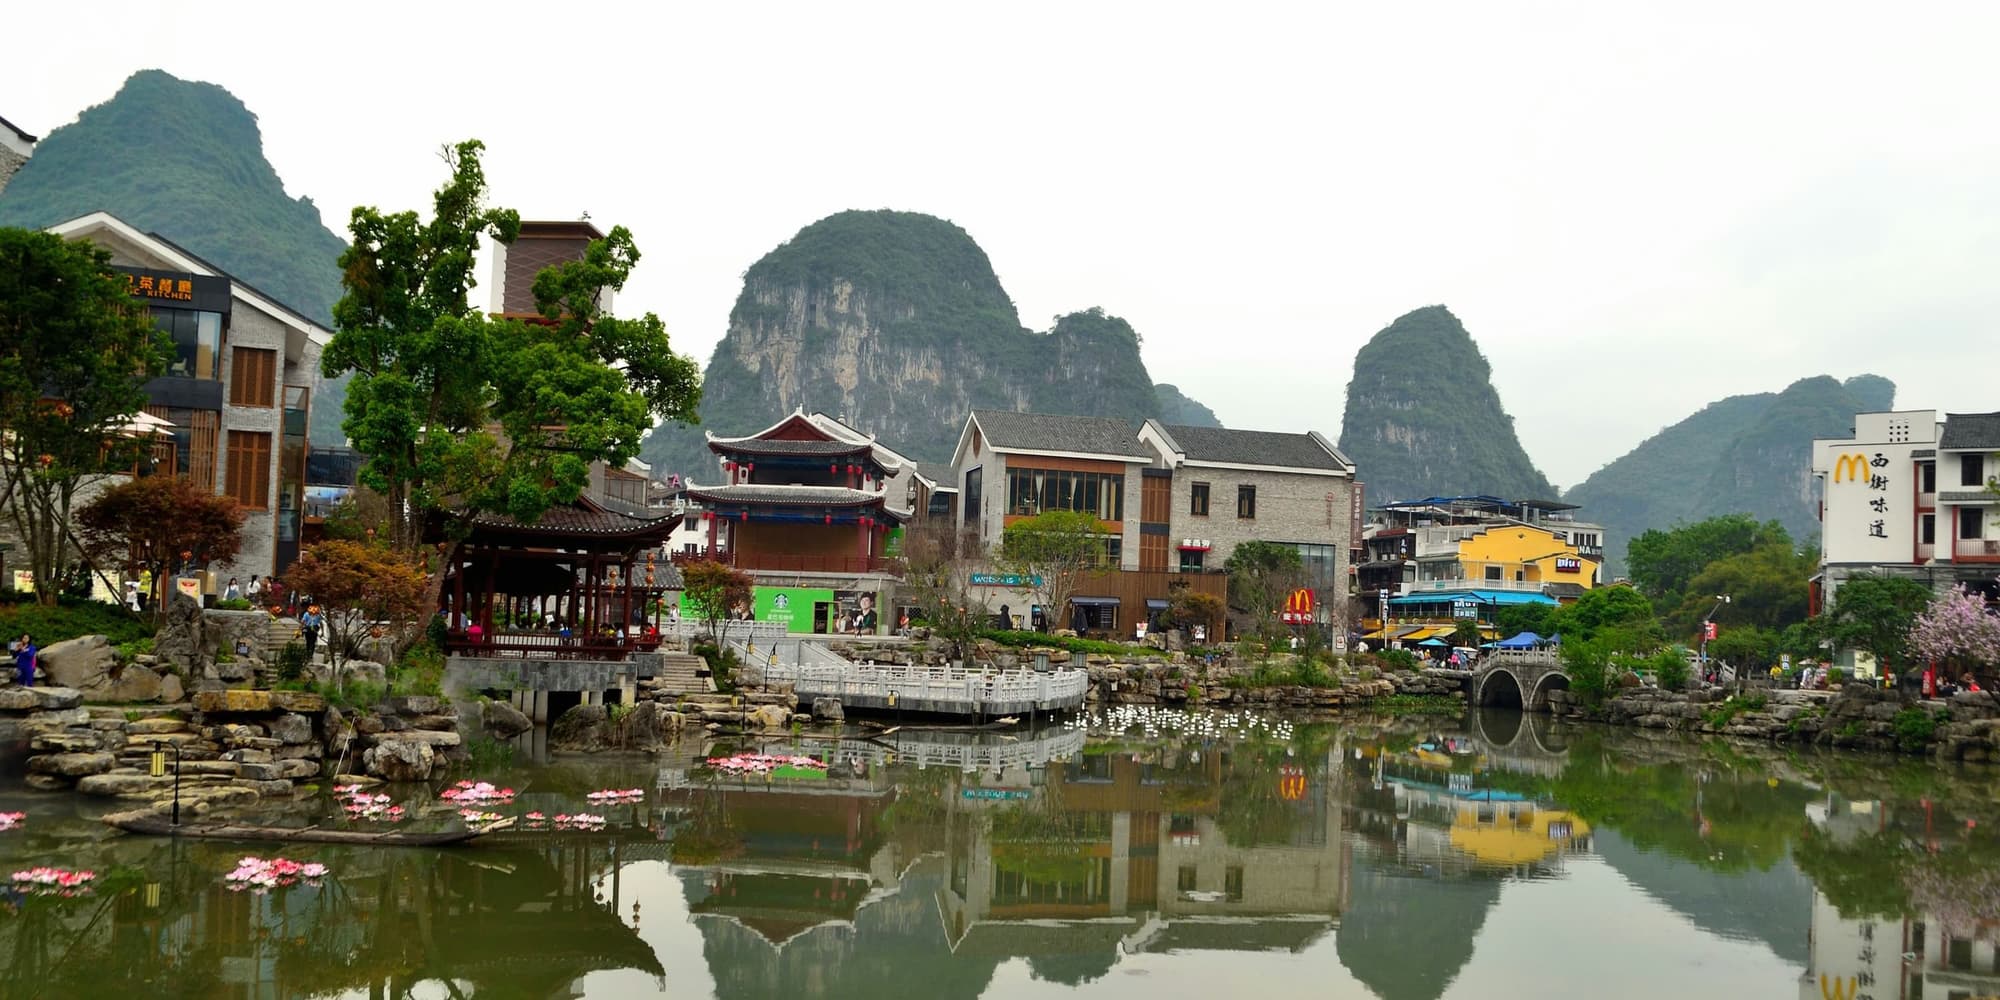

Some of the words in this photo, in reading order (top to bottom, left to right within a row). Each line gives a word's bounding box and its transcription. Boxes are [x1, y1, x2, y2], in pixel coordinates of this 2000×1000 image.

[147, 290, 192, 300] KITCHEN
[1868, 453, 1889, 539] 西街味道
